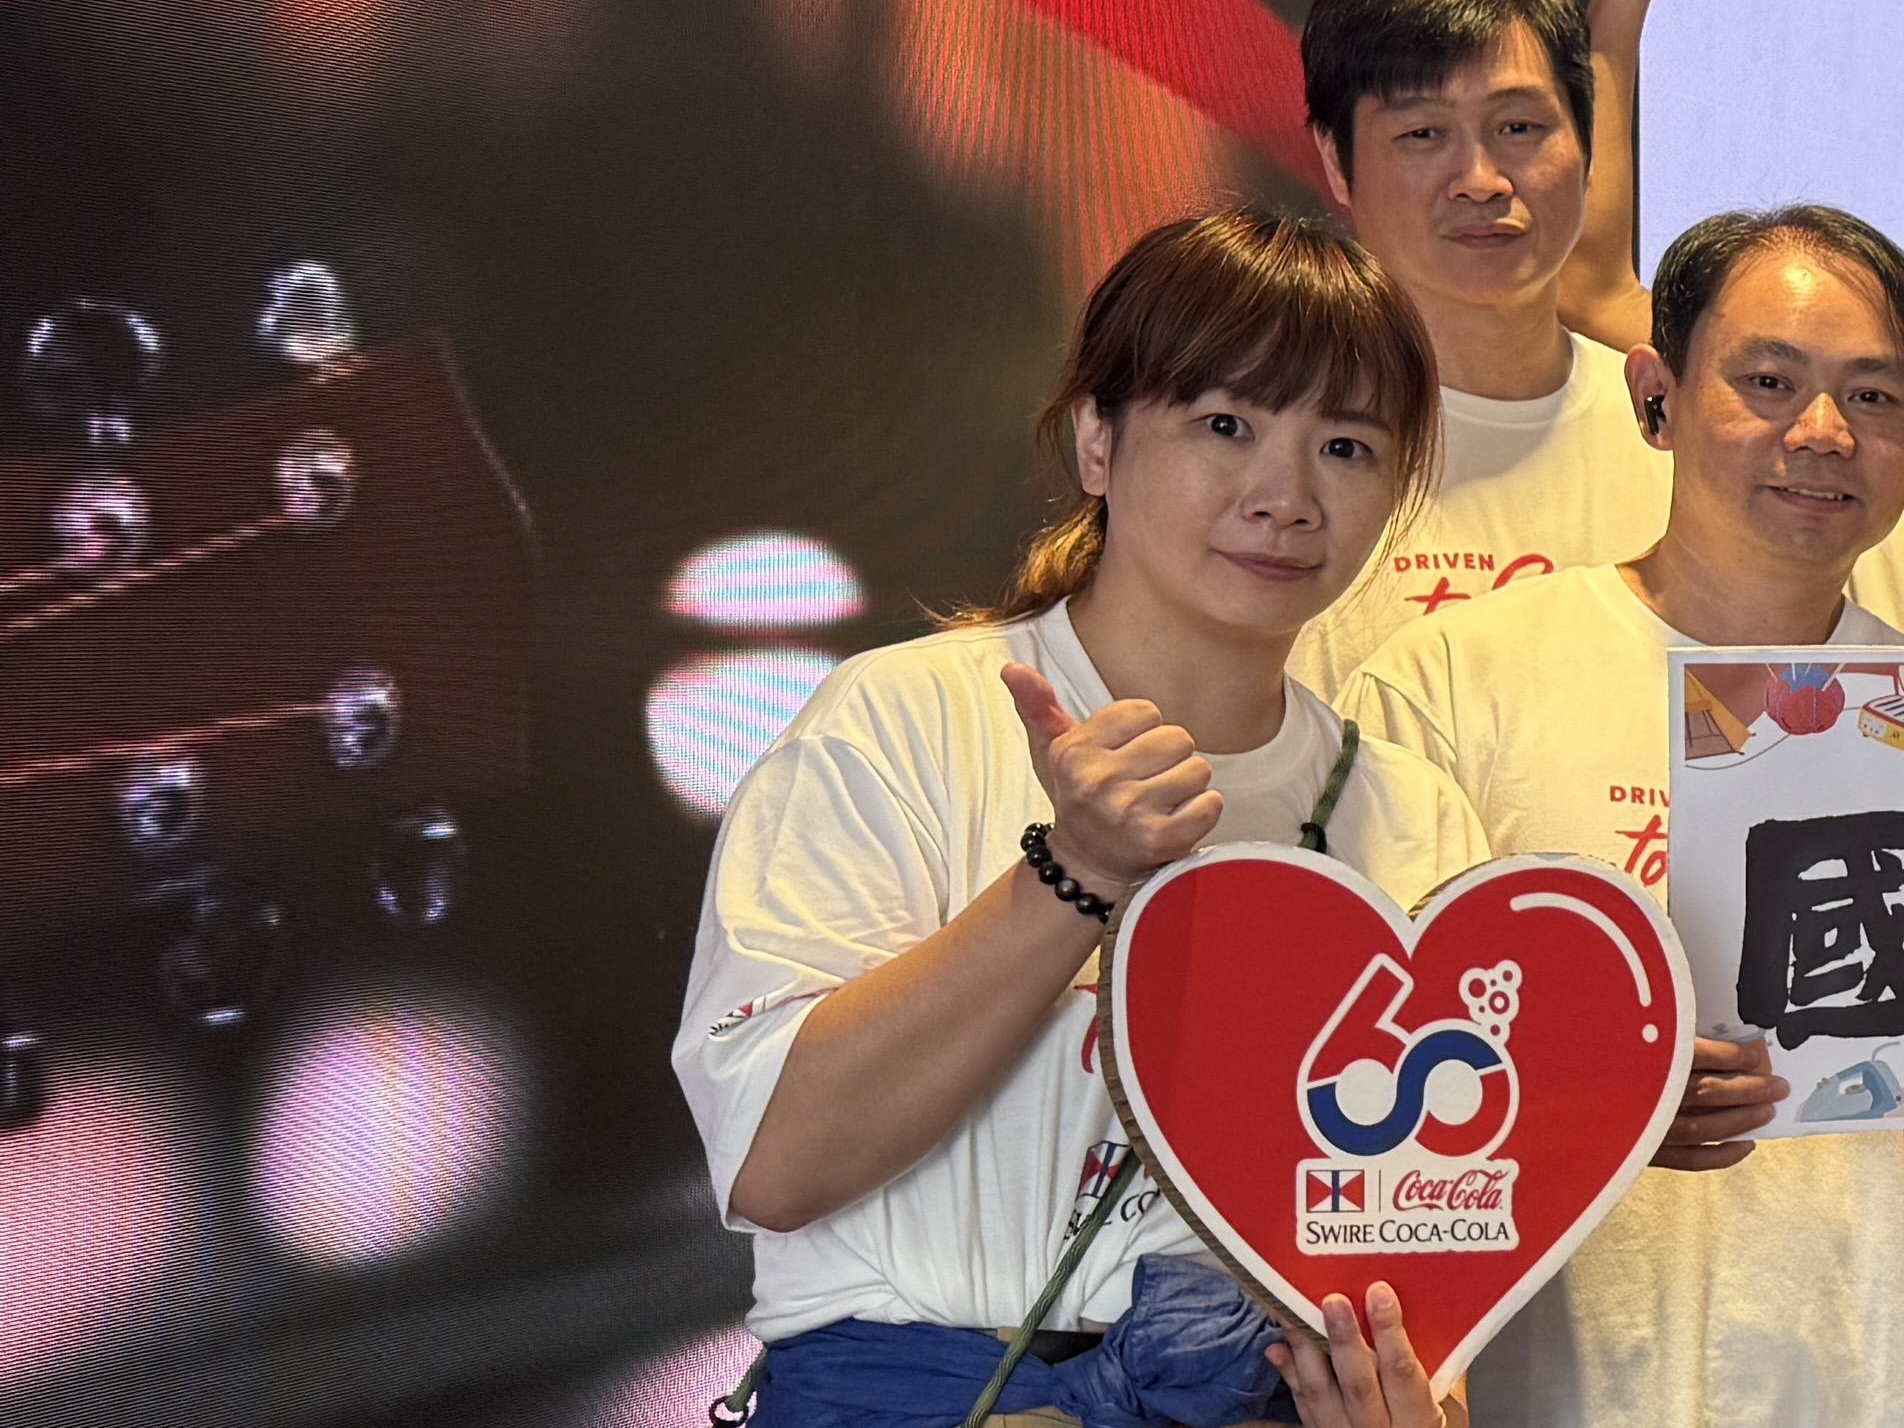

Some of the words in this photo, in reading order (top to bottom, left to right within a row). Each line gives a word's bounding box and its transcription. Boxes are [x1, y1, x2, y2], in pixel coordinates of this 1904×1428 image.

[1393, 552, 1496, 573] DRIVEN
[1609, 785, 1670, 808] DRIV
[1297, 952, 1521, 1158] 60
[1392, 1169, 1512, 1212] Coca-Cola
[1306, 1220, 1375, 1245] SWIRE
[1379, 1217, 1510, 1245] COCA-COLA
